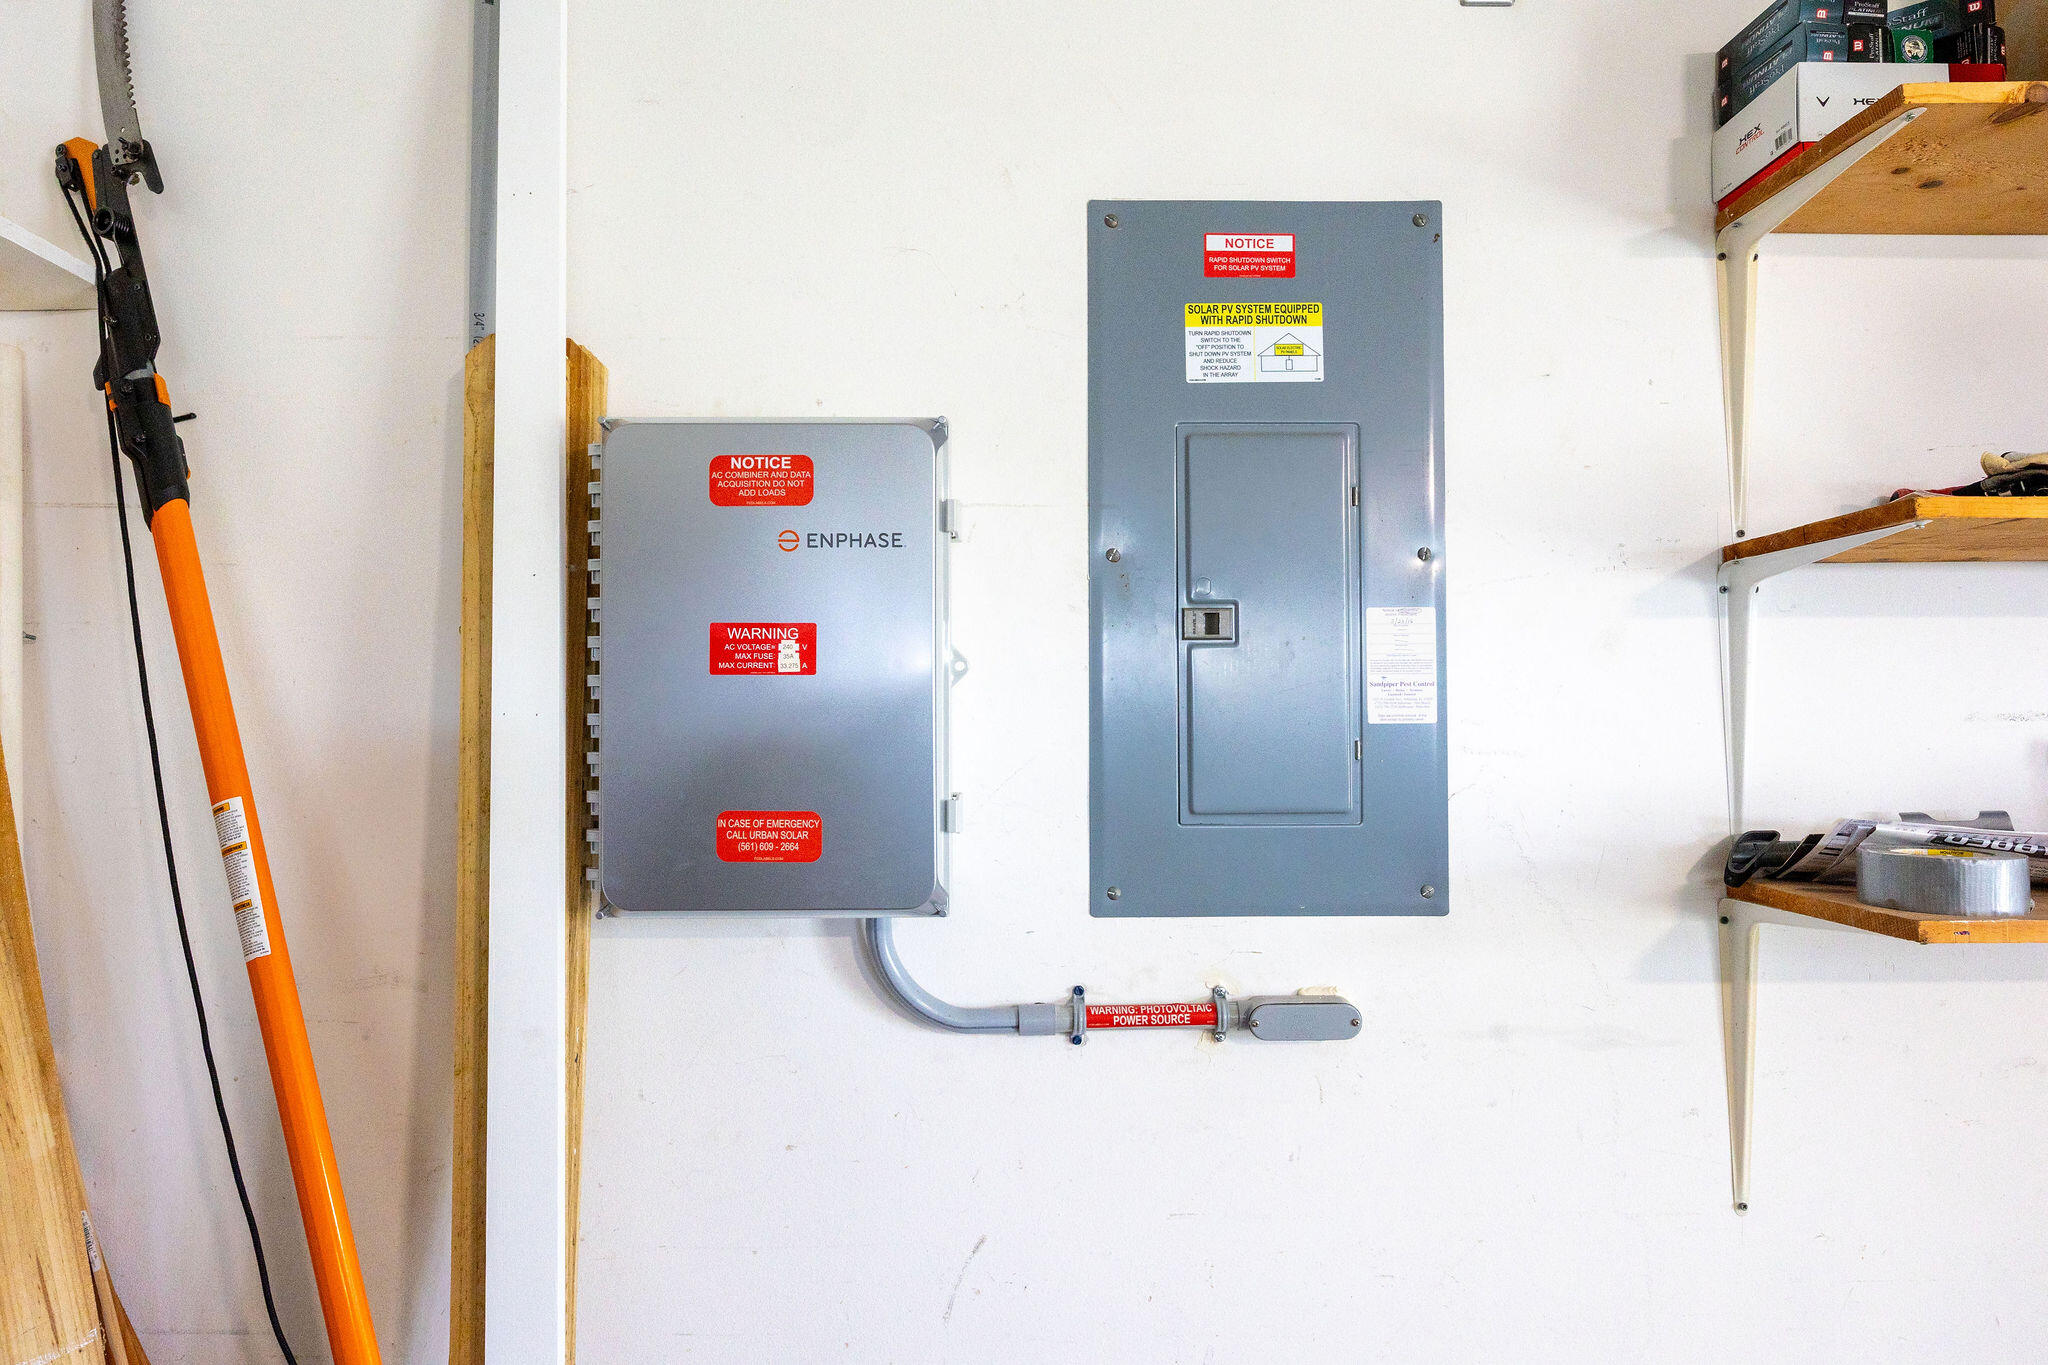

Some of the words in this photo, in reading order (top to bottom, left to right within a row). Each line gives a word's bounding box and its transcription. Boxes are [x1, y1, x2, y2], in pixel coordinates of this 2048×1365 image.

[1738, 123, 1762, 143] HEX
[1735, 131, 1765, 155] CONTROL
[1225, 238, 1274, 249] NOTICE
[1188, 304, 1219, 314] SOLAR
[1221, 304, 1233, 314] PV
[1236, 304, 1272, 314] SYSTEM
[1274, 304, 1320, 314] EQUIPPED
[1201, 315, 1223, 325] WITH
[1225, 315, 1254, 325] RAPID
[1256, 315, 1308, 325] SHUTDOWN
[730, 456, 792, 469] NOTICE
[806, 532, 903, 548] ENPHASE
[728, 628, 799, 640] WARNING
[718, 820, 726, 828] IN
[728, 820, 751, 828] CASE
[752, 820, 764, 828] OF
[766, 820, 820, 828] EMERGENCY
[726, 830, 748, 840] CALL
[750, 830, 778, 840] URBAN
[780, 830, 808, 840] SOLAR
[738, 842, 758, 852] (561)
[759, 842, 774, 852] 609
[780, 842, 799, 852] 2664
[1090, 1005, 1138, 1015] WARNING:
[1140, 1004, 1212, 1014] PHOTOVOLTAIC
[1113, 1014, 1150, 1026] POWER
[1150, 1014, 1191, 1025] SOURCE
